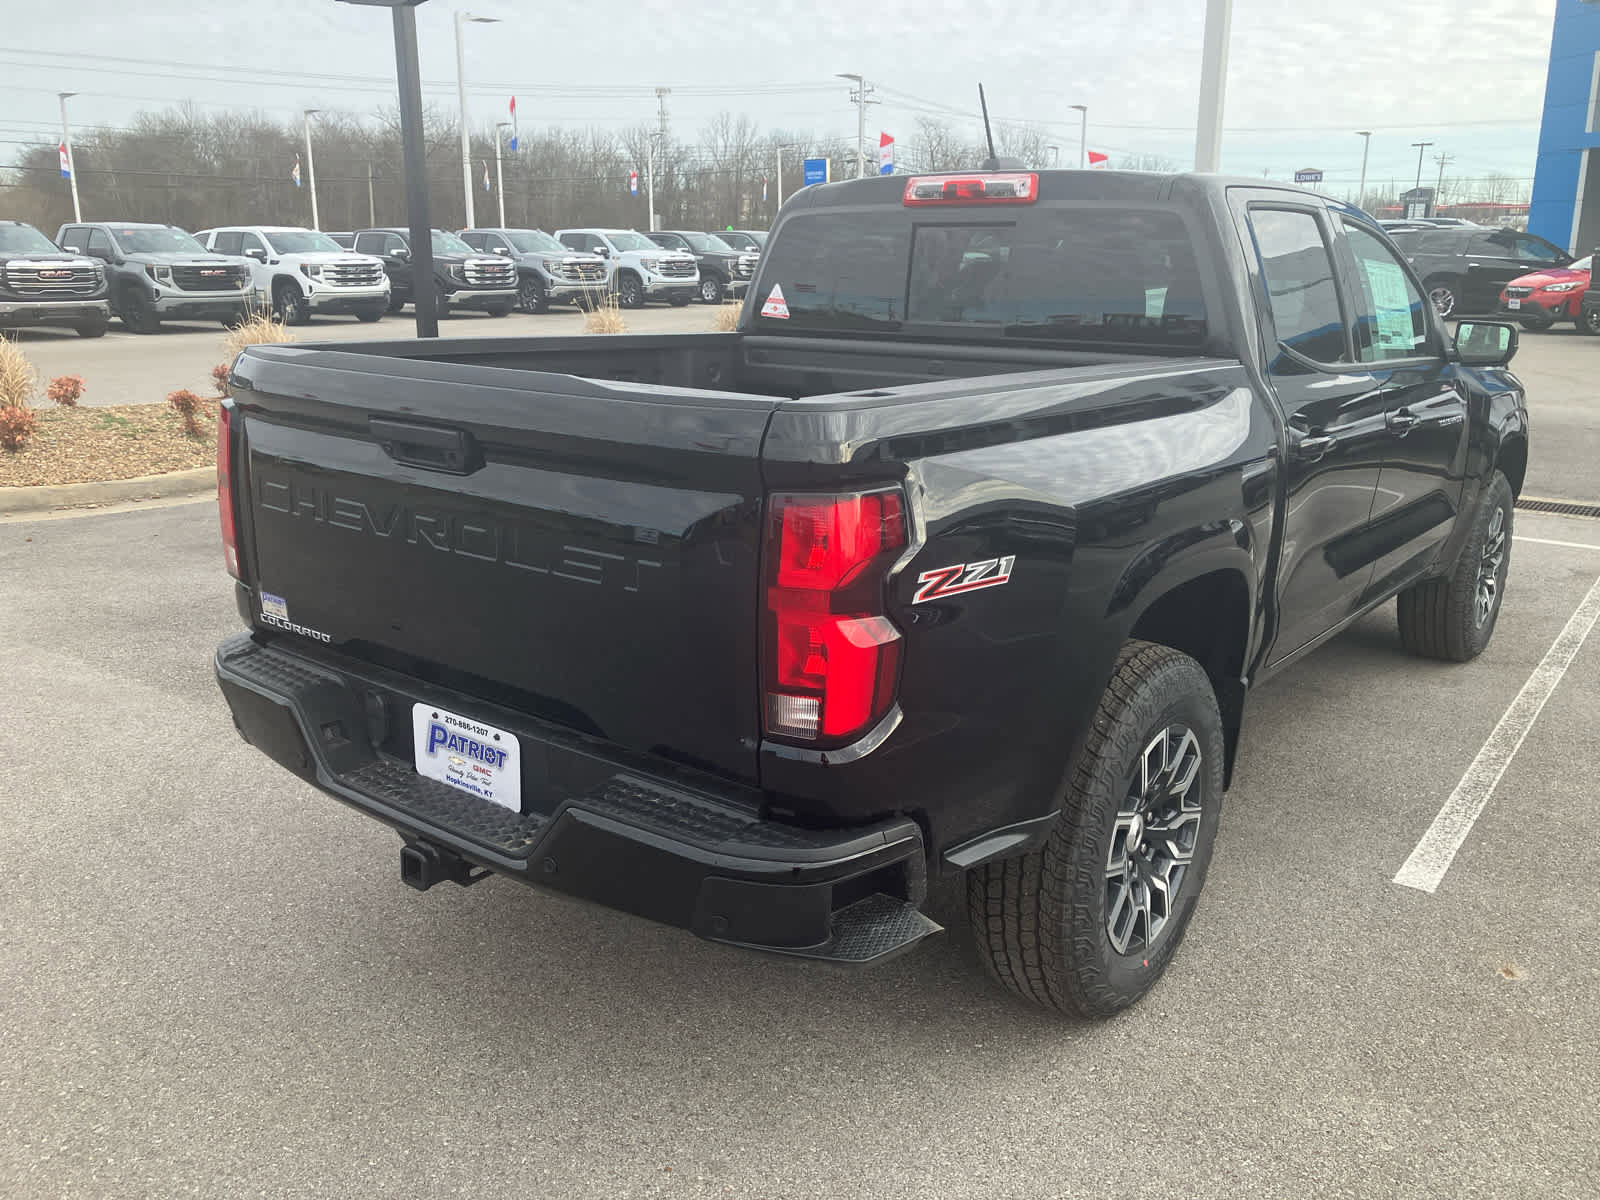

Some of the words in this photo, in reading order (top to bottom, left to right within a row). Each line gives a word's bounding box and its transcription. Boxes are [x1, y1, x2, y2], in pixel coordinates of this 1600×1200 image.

[260, 477, 662, 592] CHEVROLET
[912, 555, 1016, 605] Z71
[260, 613, 331, 643] COLORADO
[429, 724, 507, 768] PATRIOT
[446, 774, 483, 796] Hopkinsville,
[484, 789, 493, 798] KY
[472, 764, 492, 777] GMC
